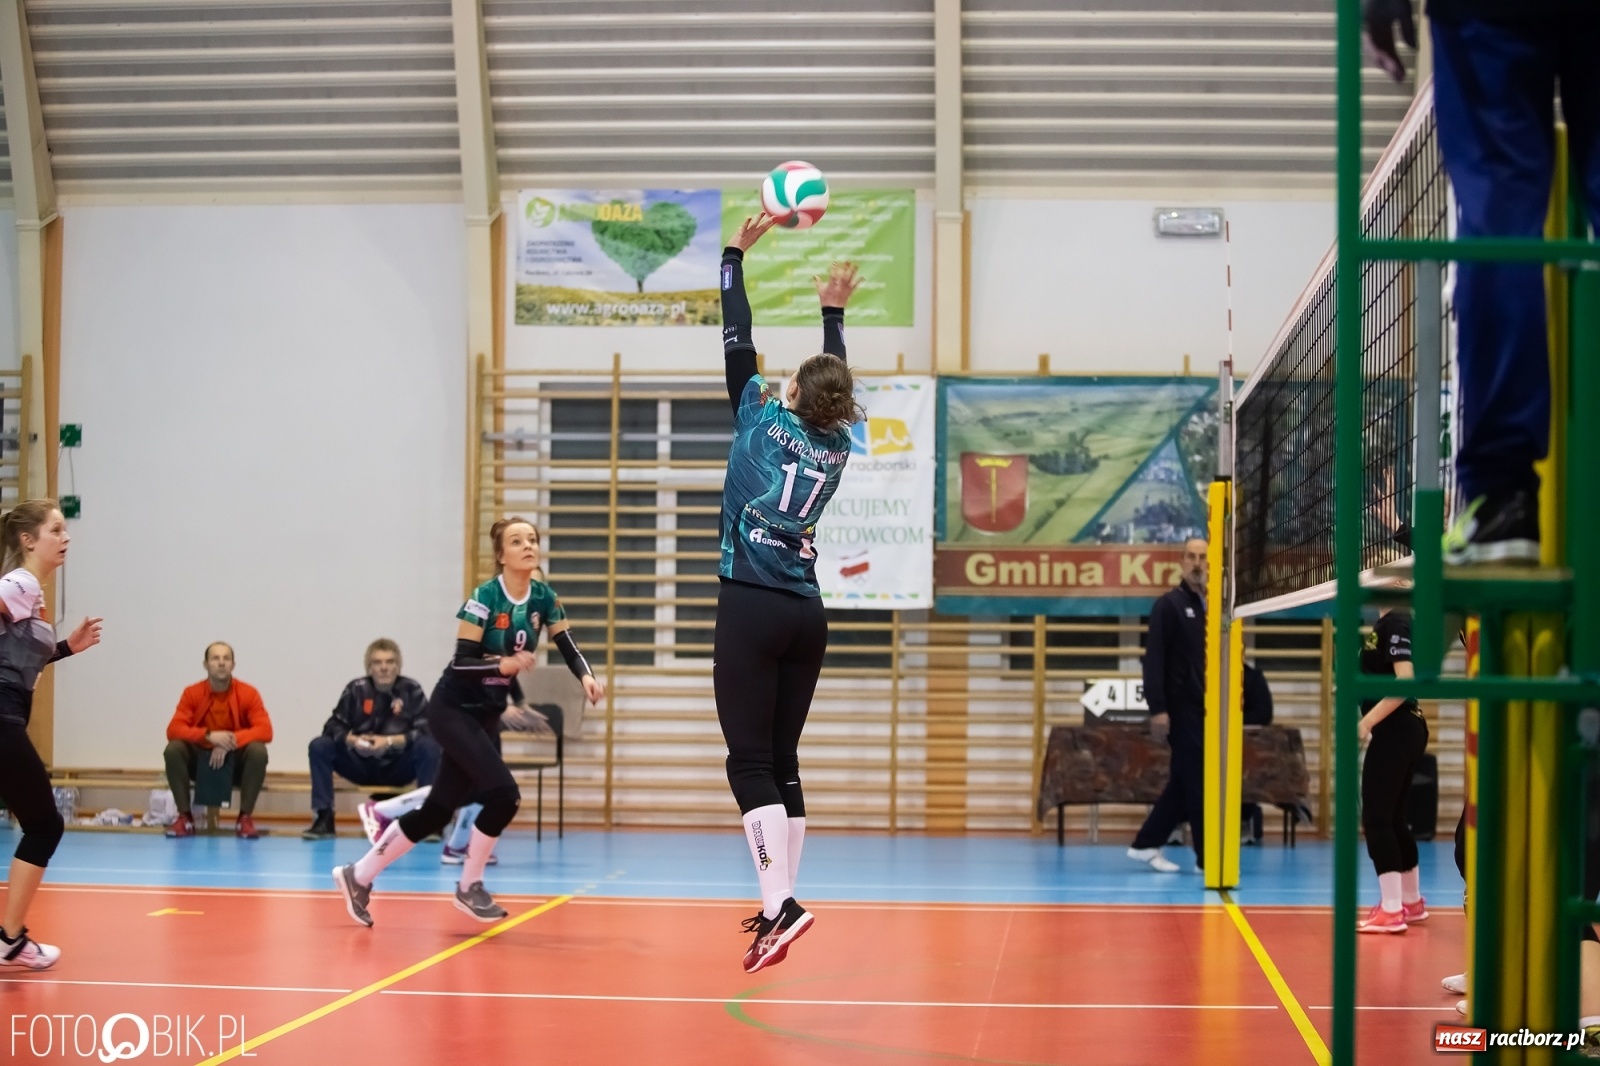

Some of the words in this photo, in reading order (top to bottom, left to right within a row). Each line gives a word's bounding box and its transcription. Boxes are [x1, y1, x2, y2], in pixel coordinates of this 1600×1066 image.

[547, 301, 687, 319] www.agrooaza.pl
[767, 422, 790, 446] UKS
[778, 461, 827, 518] 17
[965, 552, 1104, 587] Gmina
[513, 629, 527, 652] 9
[1107, 685, 1117, 702] 4
